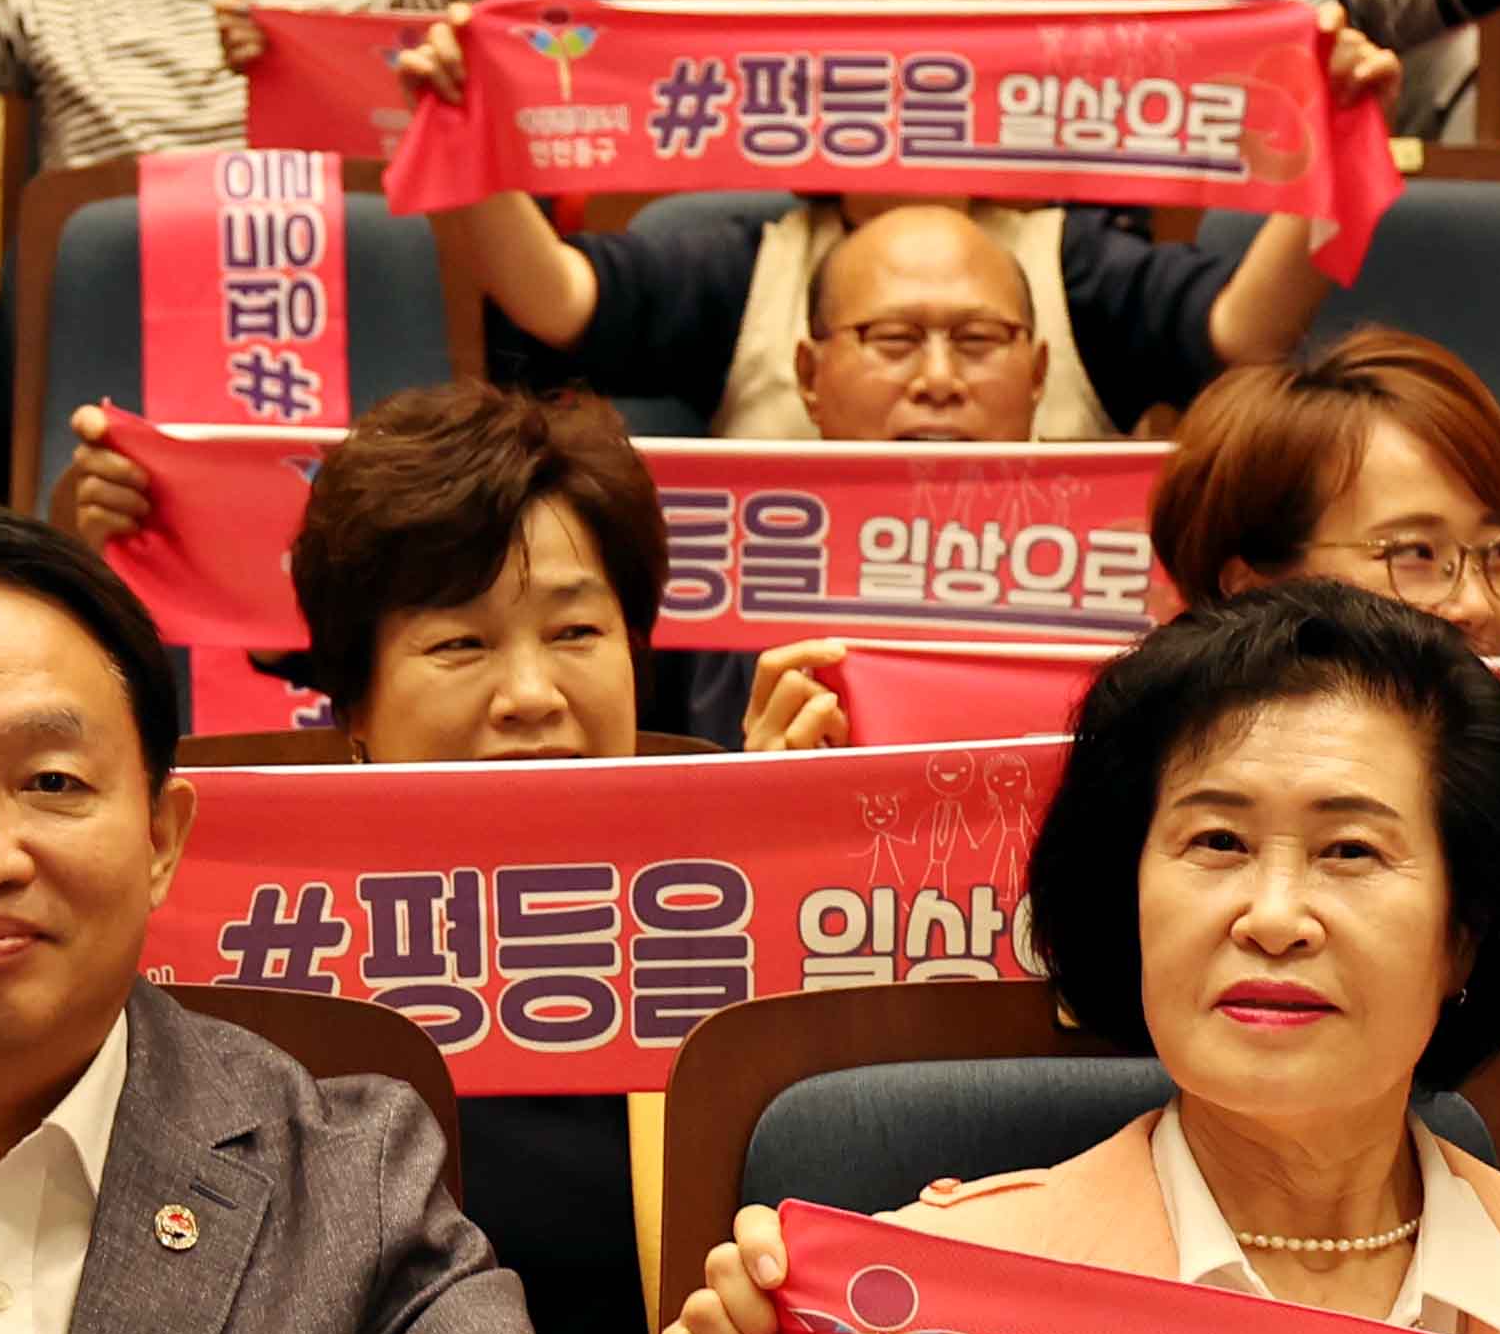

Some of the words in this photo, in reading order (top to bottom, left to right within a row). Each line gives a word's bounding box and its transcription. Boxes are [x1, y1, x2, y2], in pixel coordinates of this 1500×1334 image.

[646, 53, 974, 164] #평등을
[999, 72, 1248, 157] 일상으로
[857, 516, 1155, 615] 일상으로
[214, 859, 757, 1057] #평등을
